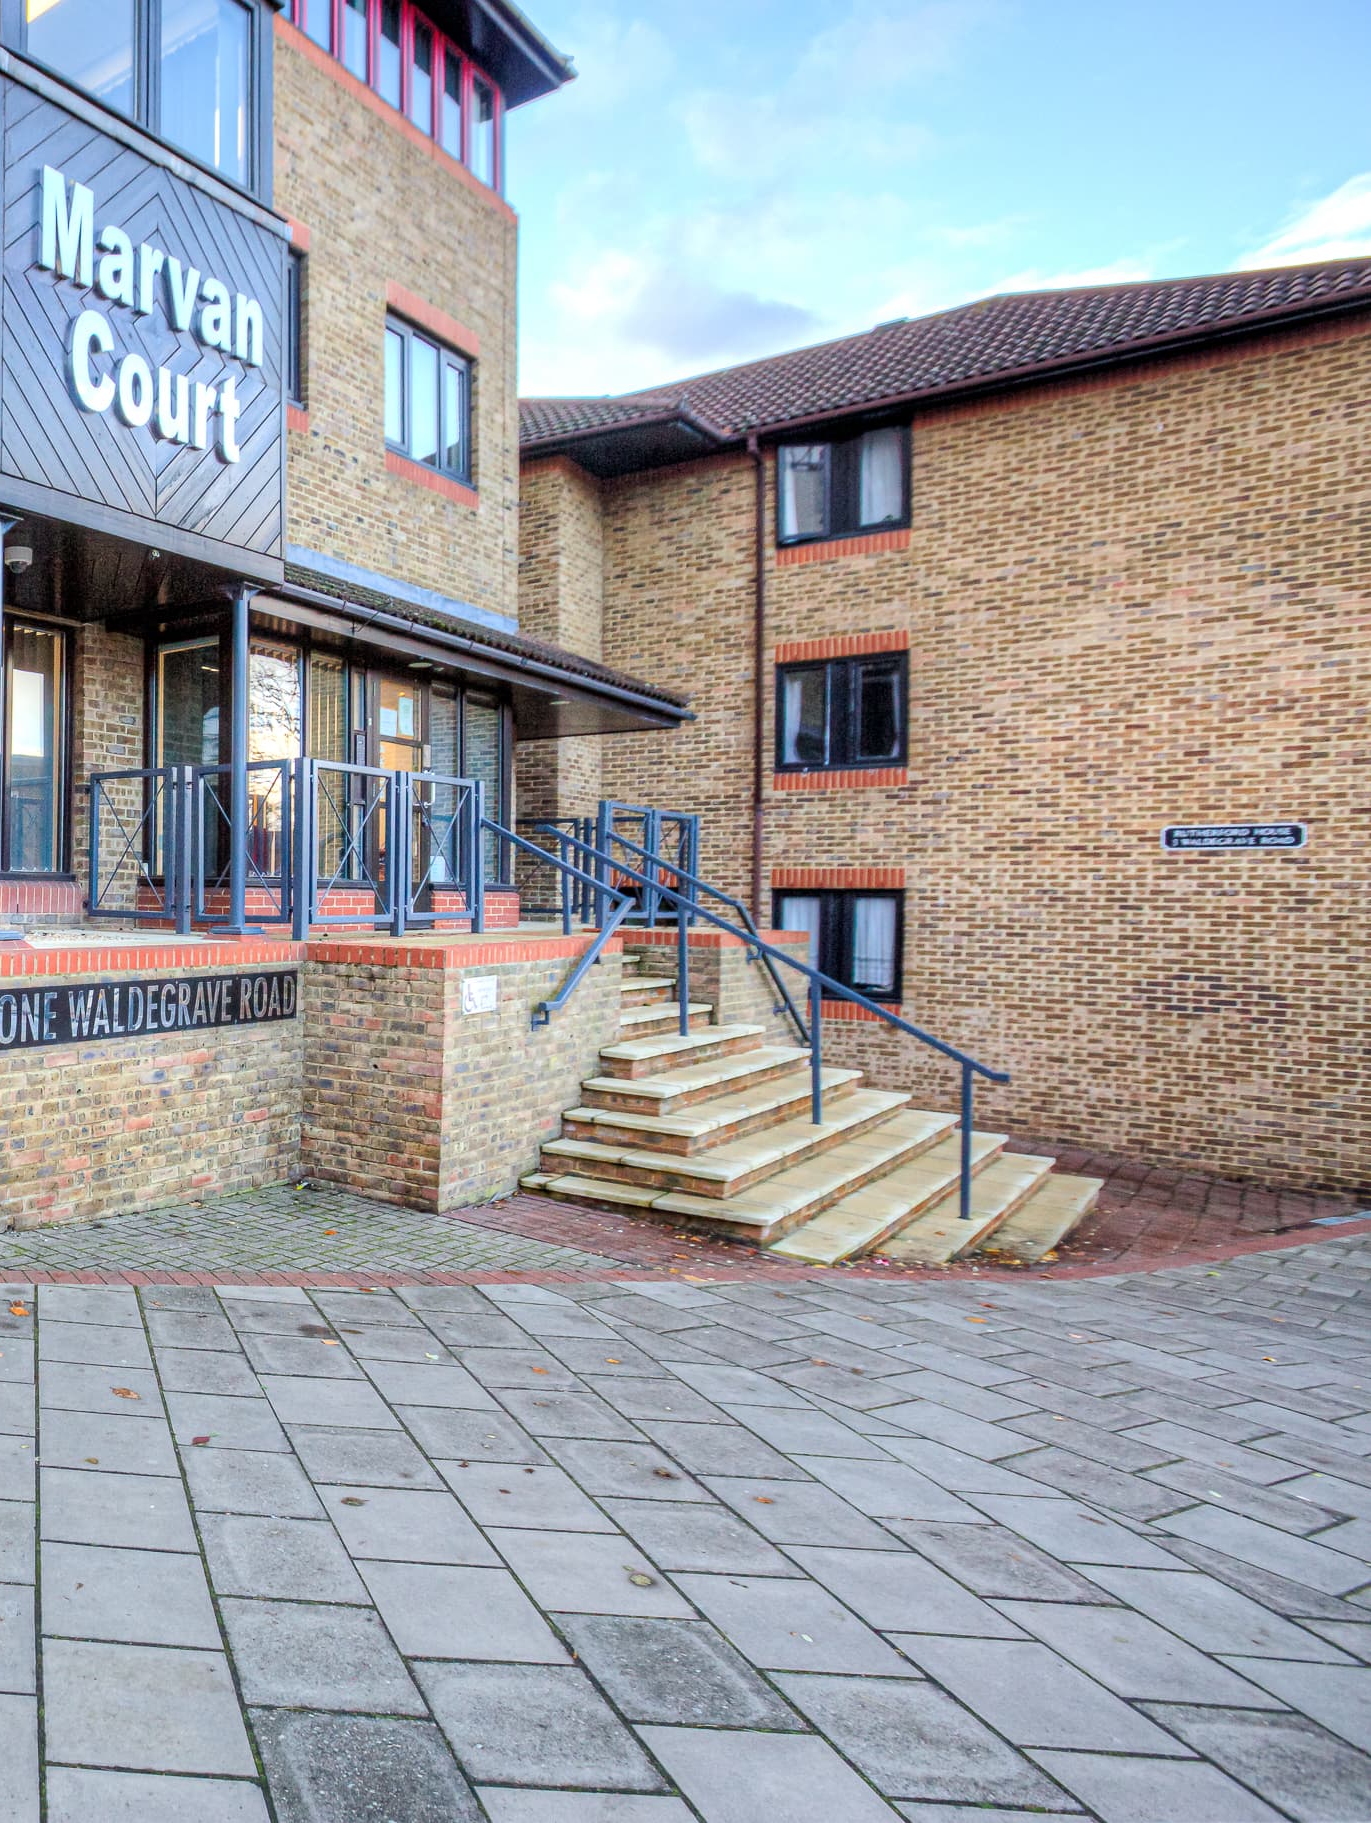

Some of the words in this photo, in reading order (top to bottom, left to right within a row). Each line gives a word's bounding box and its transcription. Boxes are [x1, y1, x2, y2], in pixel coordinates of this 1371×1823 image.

[40, 164, 264, 368] Marvan
[68, 309, 241, 464] Court
[1180, 836, 1257, 846] WALDEGRAVE
[1259, 836, 1296, 845] ROAD
[1252, 827, 1293, 836] HOUSE
[68, 979, 233, 1038] WALDEGRAVE
[239, 975, 296, 1020] ROAD
